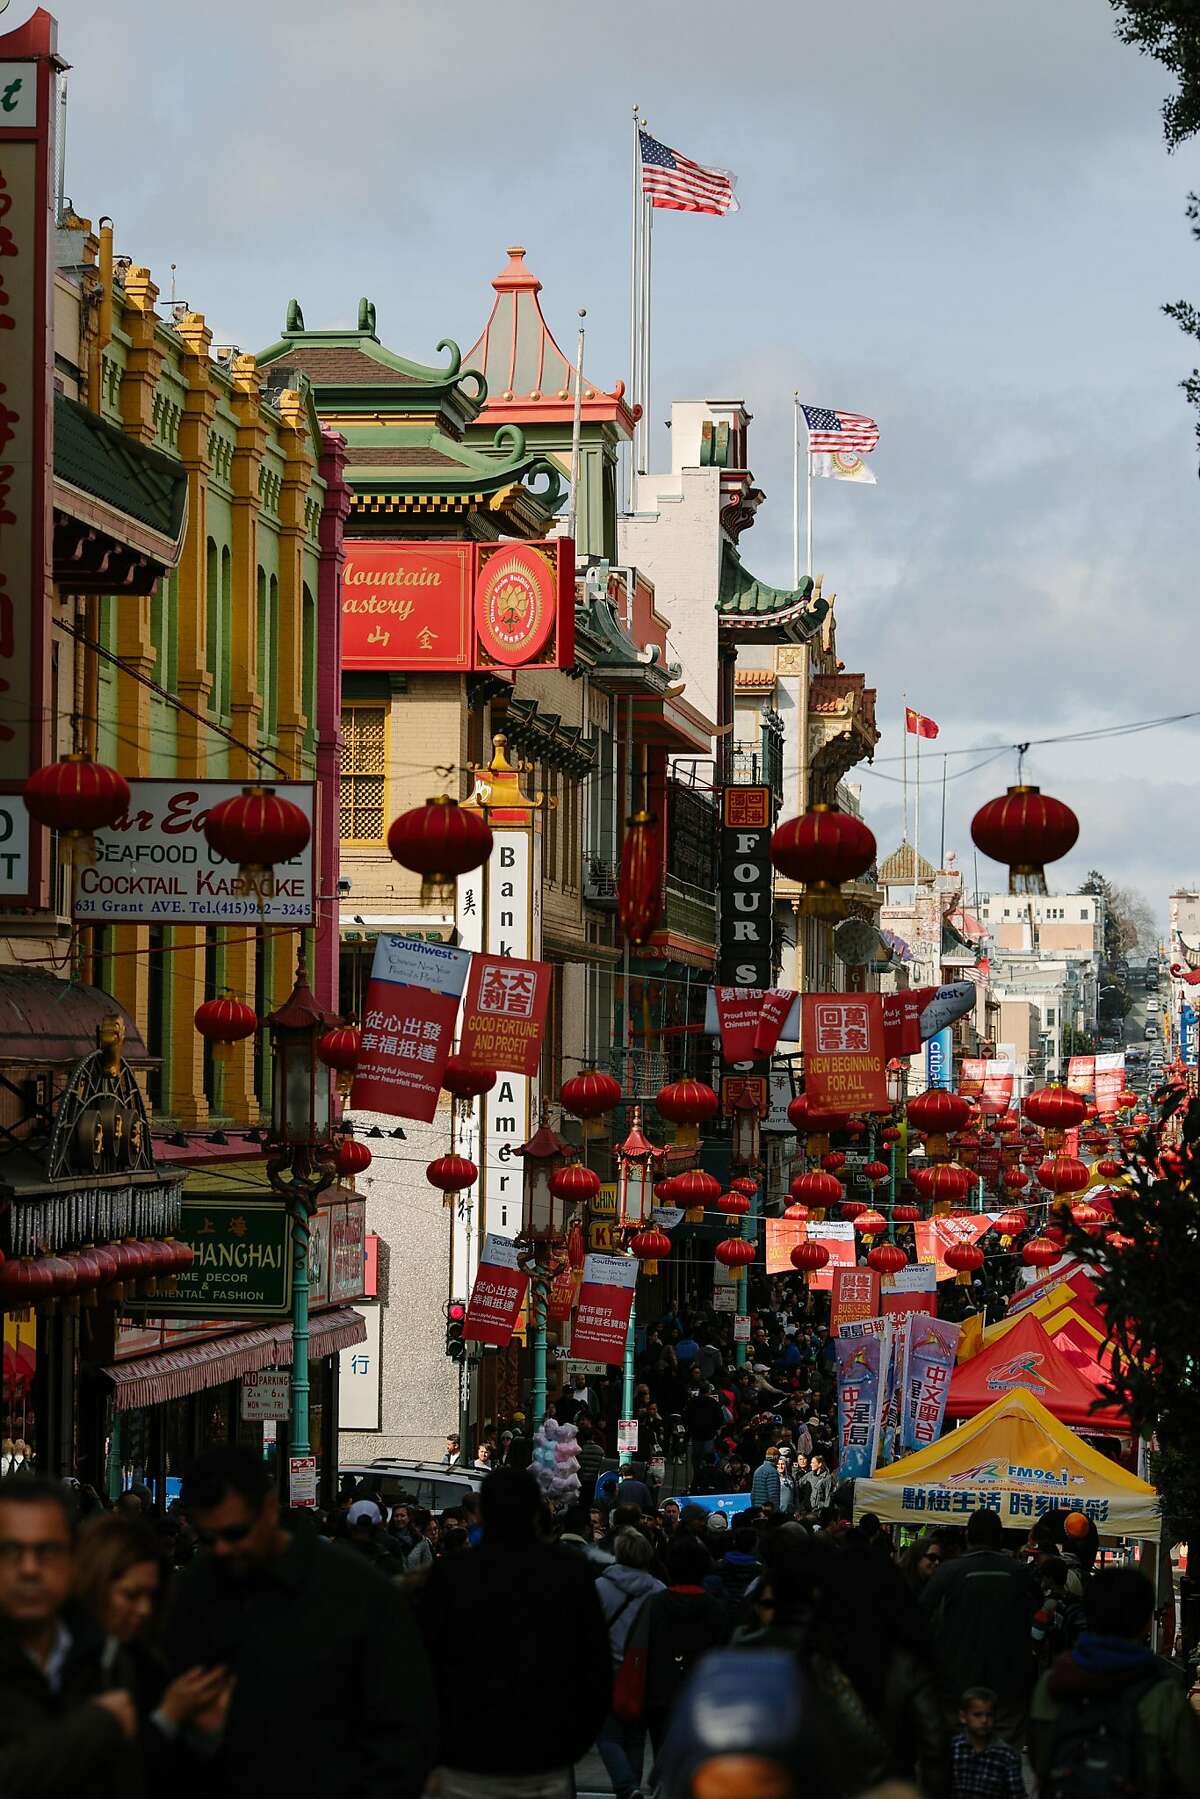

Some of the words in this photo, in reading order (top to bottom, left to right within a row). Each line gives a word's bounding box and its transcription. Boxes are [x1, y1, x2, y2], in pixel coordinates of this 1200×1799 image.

[342, 595, 415, 621] astery
[109, 810, 154, 832] ar
[161, 791, 210, 834] Ea
[81, 868, 188, 896] COCKTAIL
[196, 869, 305, 897] KARAOKE
[733, 833, 760, 942] FOUR
[75, 901, 97, 913] 631
[102, 901, 144, 913] Grant
[152, 902, 186, 914] AVE.
[500, 846, 516, 958] Bank
[390, 938, 454, 960] Southwest
[904, 1003, 919, 1011] Star
[365, 1009, 442, 1042] 從心出發
[468, 1015, 496, 1032] GOOD
[496, 1019, 540, 1039] FORTUNE
[884, 1019, 901, 1028] heart
[361, 1032, 437, 1063] 幸福抵達
[473, 1034, 494, 1050] AND
[495, 1035, 528, 1054] PROFIT
[376, 1065, 397, 1075] joyful
[397, 1068, 425, 1081] journey
[810, 1057, 831, 1074] NEW
[832, 1056, 881, 1073] BEGINNING
[381, 1075, 411, 1087] heartfelt
[827, 1074, 847, 1090] FOR
[848, 1074, 864, 1090] ALL
[495, 1081, 516, 1227] Ameri
[191, 1240, 282, 1268] HANGHAI
[592, 1257, 629, 1268] Southwest
[174, 1272, 200, 1282] OME
[206, 1272, 249, 1283] DECOR
[201, 1281, 209, 1290] &
[213, 1290, 264, 1301] FASHION
[244, 1372, 257, 1386] NO
[259, 1375, 288, 1386] PARKING
[1008, 1465, 1068, 1485] FM96.1
[901, 1487, 1001, 1514] 點綴生活
